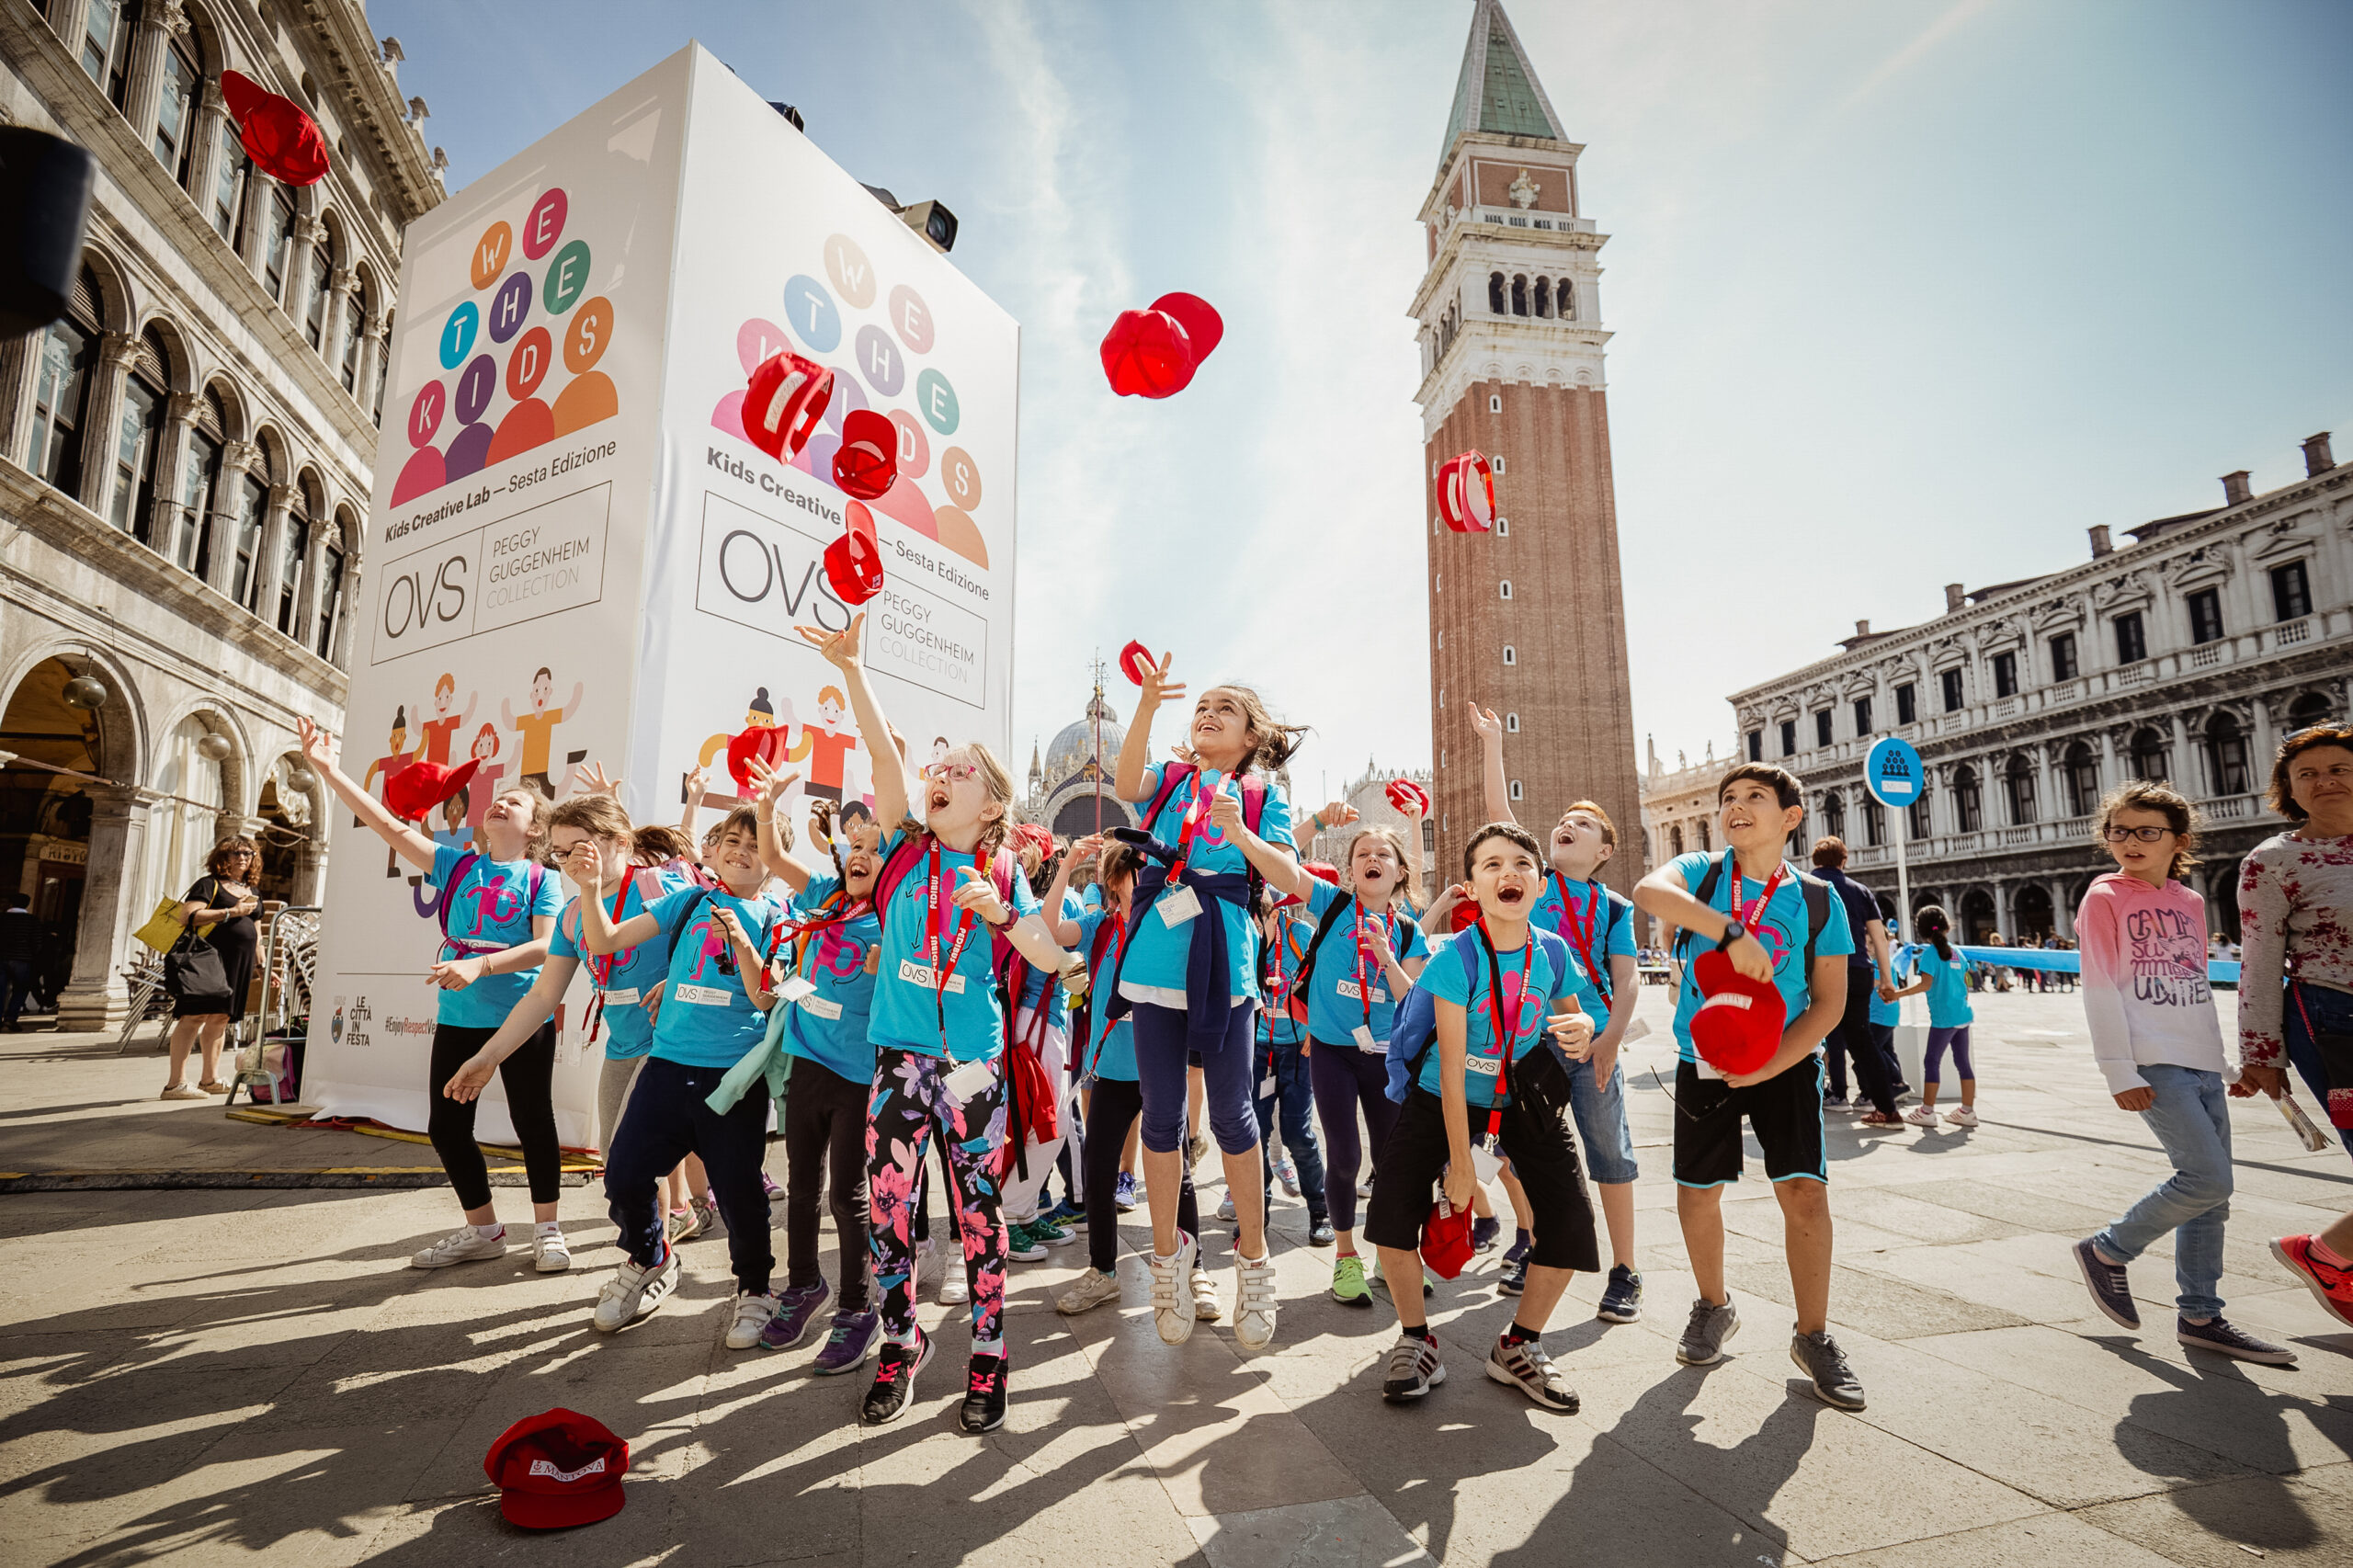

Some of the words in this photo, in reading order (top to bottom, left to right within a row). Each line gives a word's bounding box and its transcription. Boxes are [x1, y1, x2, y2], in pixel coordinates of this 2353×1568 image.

[385, 518, 411, 544] Kids
[412, 500, 464, 531] Creative
[465, 485, 491, 511] Lab
[508, 465, 548, 493] Sesta
[551, 440, 617, 478] Edizione
[707, 446, 756, 485] Kids
[759, 472, 842, 527] Creative
[895, 540, 935, 573] Sesta
[938, 561, 990, 601] Edizione
[493, 525, 541, 559] PEGGY
[489, 536, 590, 585] GUGGENHEIM
[384, 555, 467, 640] OVS
[486, 565, 581, 610] COLLECTION
[719, 529, 852, 633] OVS
[882, 589, 932, 624] PEGGY
[880, 613, 974, 665] GUGGENHEIM
[879, 636, 968, 684] COLLECTION
[930, 874, 938, 910] PEDIBUS
[1733, 880, 1742, 912] PEDIBUS
[1749, 894, 1768, 926] PEDIBUS
[930, 935, 938, 972] PEDIBUS
[950, 927, 967, 963] PEDIBUS
[903, 963, 927, 983] OVS
[1338, 981, 1360, 996] OVS
[356, 995, 366, 1008] LE
[677, 986, 698, 1000] OVS
[350, 1005, 372, 1022] CITTÀ
[351, 1020, 360, 1033] IN
[347, 1033, 370, 1047] FESTA
[1466, 1058, 1496, 1073] OVS
[543, 1460, 604, 1482] MANTOVA
